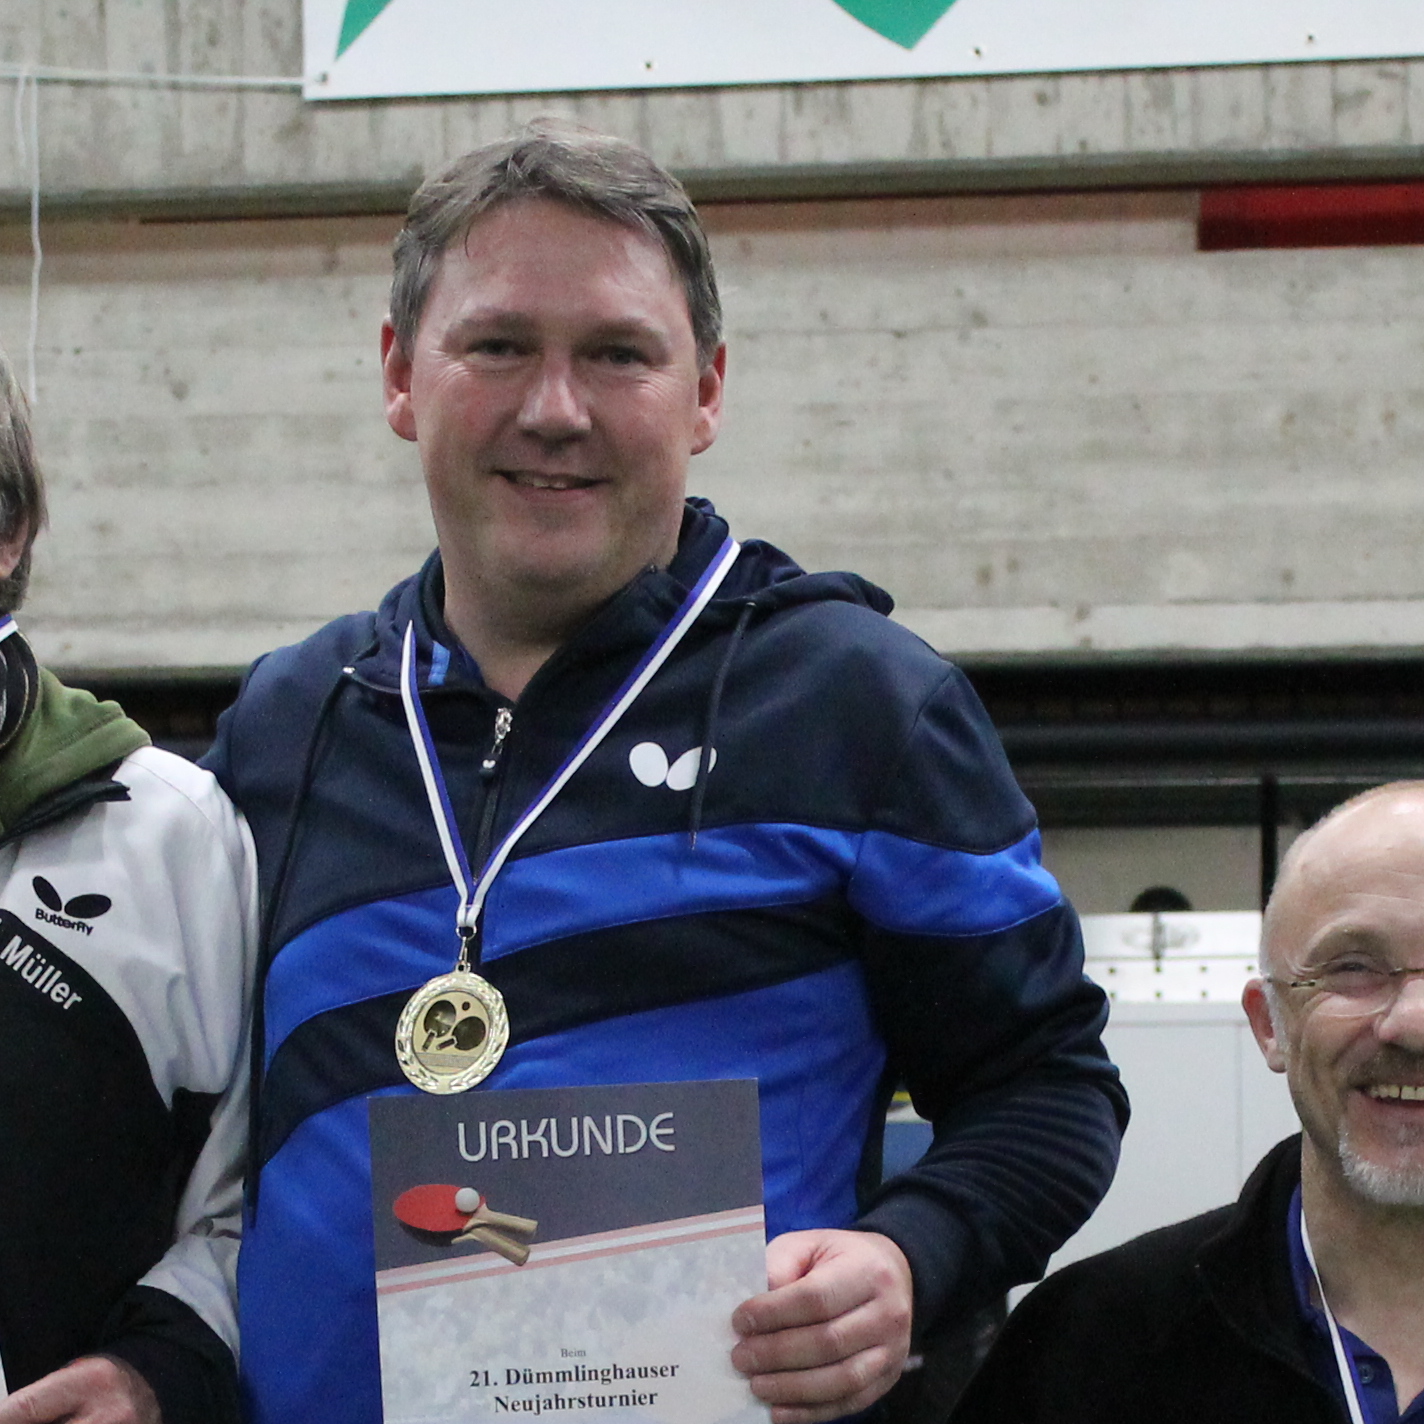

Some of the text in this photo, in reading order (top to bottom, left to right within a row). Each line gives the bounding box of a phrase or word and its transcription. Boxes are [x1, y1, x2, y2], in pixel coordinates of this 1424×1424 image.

[35, 908, 94, 936] Butterfly
[0, 934, 83, 1010] Müller
[458, 1111, 675, 1162] URKUNDE
[560, 1349, 586, 1358] Beim
[469, 1364, 679, 1387] 21. Dümmlinghauser
[494, 1389, 658, 1416] Neujahrsturnier
